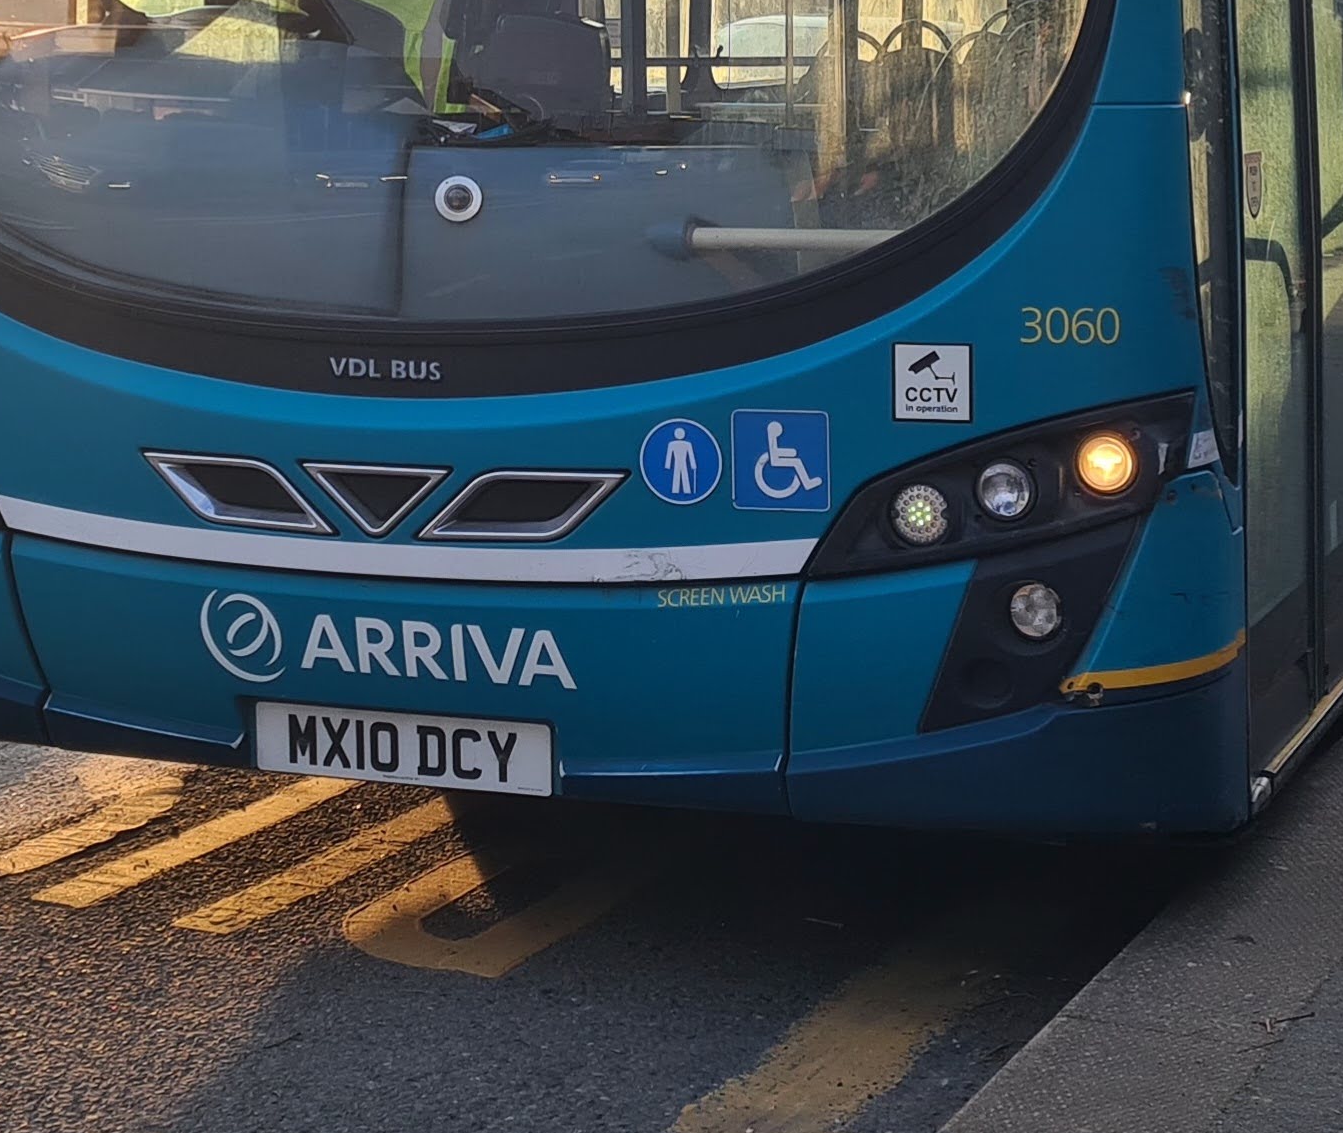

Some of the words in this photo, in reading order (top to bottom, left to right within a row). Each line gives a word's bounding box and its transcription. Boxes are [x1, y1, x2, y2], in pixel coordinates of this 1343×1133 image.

[1020, 307, 1120, 344] 3060
[329, 357, 381, 378] VDL
[391, 359, 441, 380] BUS
[905, 387, 958, 403] CCTV
[916, 404, 958, 413] operation
[658, 588, 725, 608] SCREEN
[730, 584, 786, 604] WASH
[300, 614, 578, 690] ARRIVA
[288, 714, 399, 773] MX10
[417, 725, 518, 783] DCY
